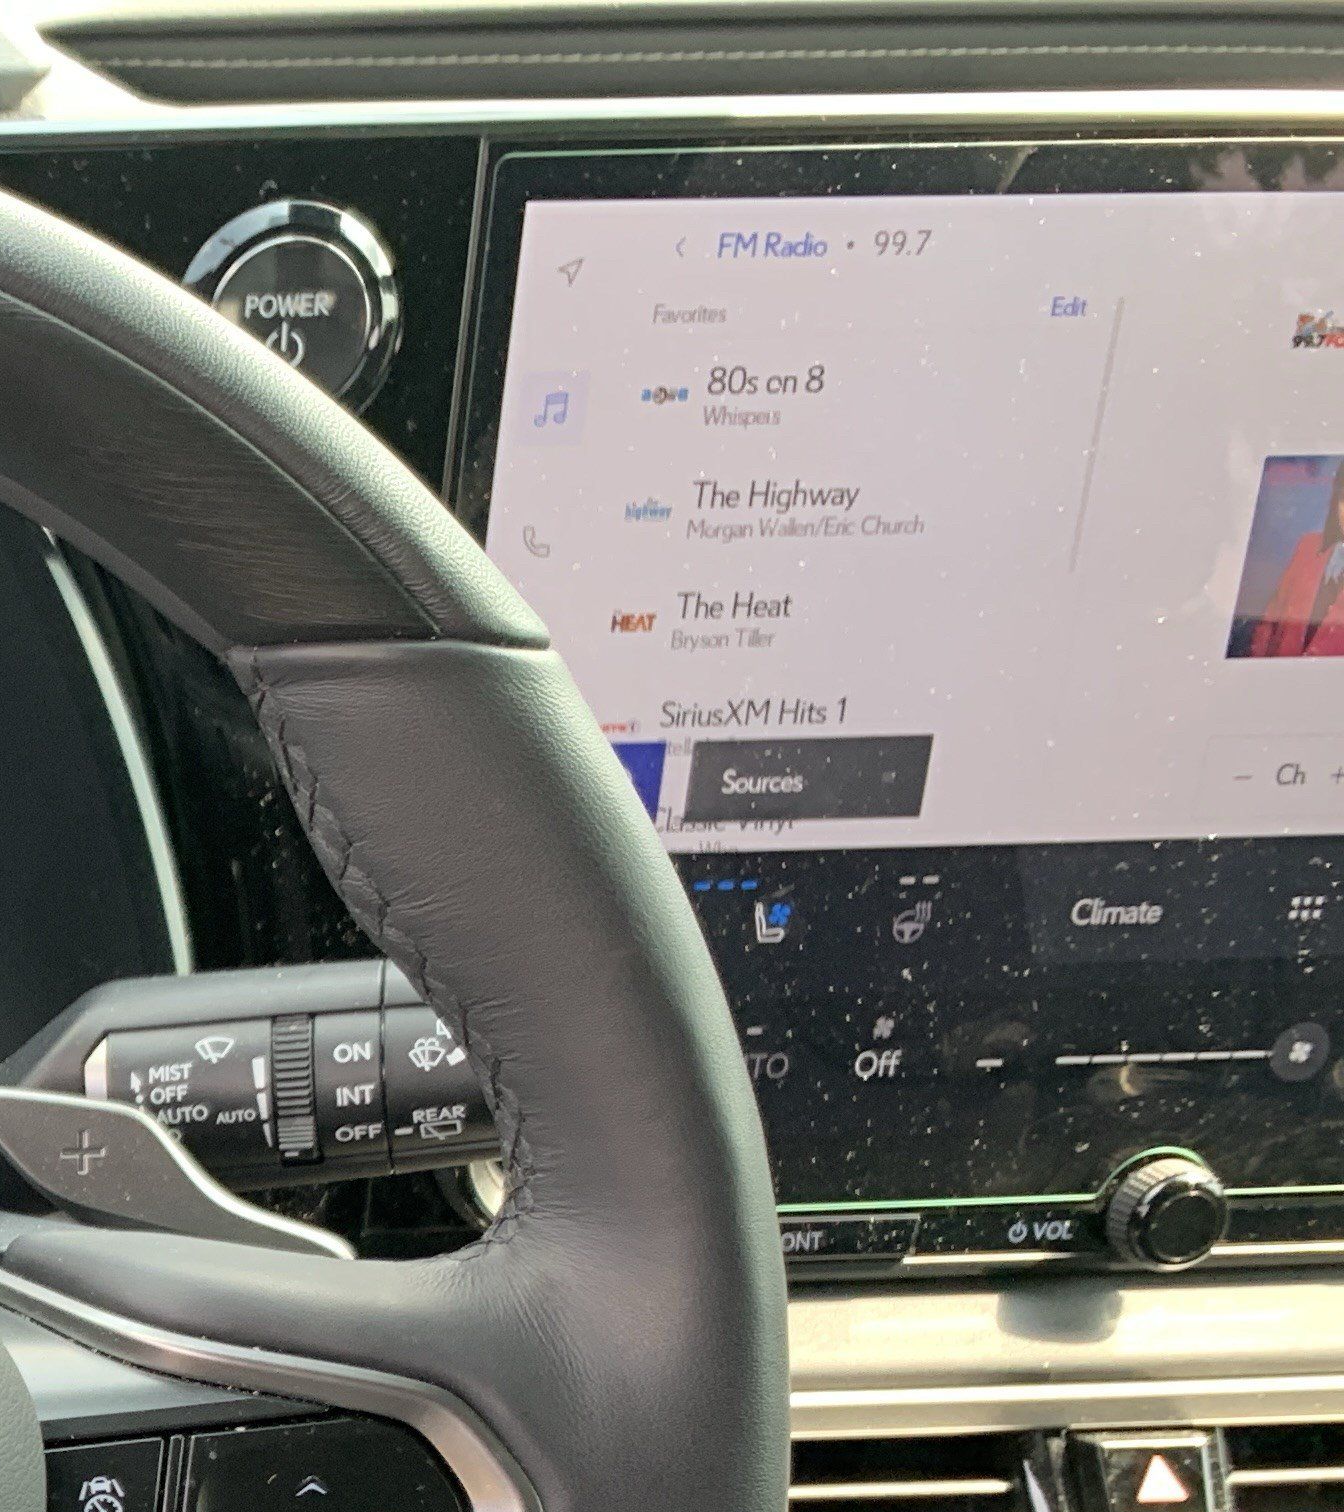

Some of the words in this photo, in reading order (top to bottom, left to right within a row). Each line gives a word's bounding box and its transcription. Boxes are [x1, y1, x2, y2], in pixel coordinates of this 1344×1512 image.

[717, 232, 758, 258] FM
[765, 231, 828, 257] Radio
[874, 229, 932, 256] 99.7
[244, 291, 331, 319] POWER
[652, 304, 728, 325] Favorites
[1050, 296, 1088, 317] Edit
[707, 366, 759, 395] 80s
[765, 373, 798, 395] on
[804, 365, 826, 394] 8
[693, 479, 741, 509] The
[748, 479, 861, 514] Highway
[686, 519, 753, 543] Morgan
[860, 514, 926, 538] Church
[676, 591, 724, 620] The
[730, 591, 793, 620] Heat
[670, 629, 730, 652] Bryson
[734, 628, 774, 650] Tiller
[659, 699, 771, 728] SiriusXM
[777, 697, 828, 726] Hits
[835, 696, 849, 724] 1
[721, 768, 805, 796] Sources
[1275, 762, 1307, 786] Ch
[1070, 898, 1163, 926] Climate
[333, 1041, 372, 1064] ON
[854, 1050, 904, 1078] Off
[148, 1062, 193, 1083] MIST
[746, 1051, 790, 1080] TO
[150, 1084, 189, 1105] OFF
[335, 1083, 376, 1107] INT
[157, 1106, 209, 1125] AUTO
[216, 1109, 257, 1125] AUTO
[412, 1104, 467, 1124] REAR
[334, 1121, 383, 1142] OFF
[782, 1231, 824, 1253] ONT
[1033, 1221, 1075, 1242] VOL
